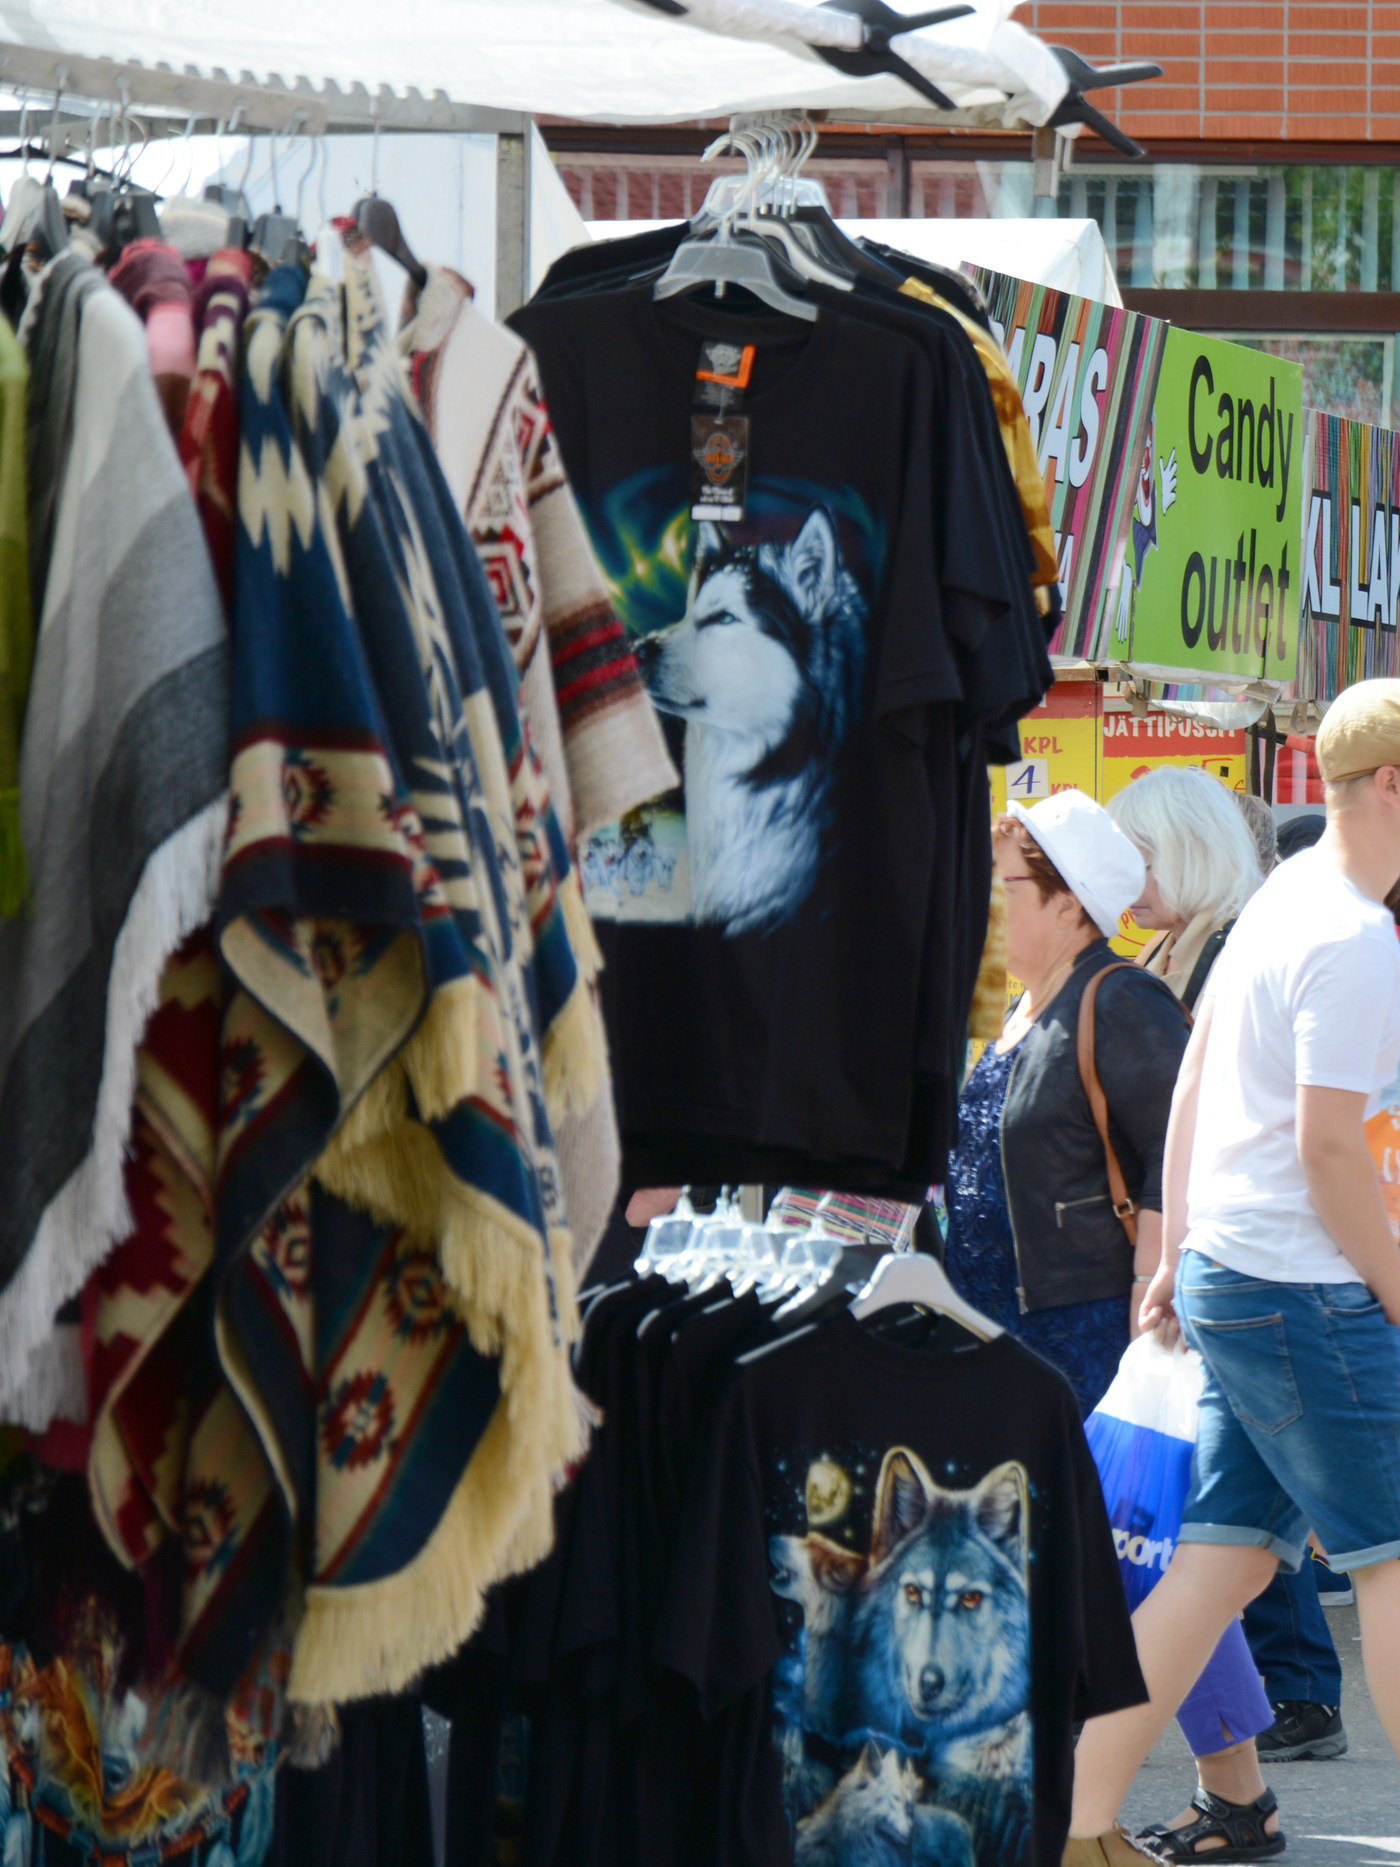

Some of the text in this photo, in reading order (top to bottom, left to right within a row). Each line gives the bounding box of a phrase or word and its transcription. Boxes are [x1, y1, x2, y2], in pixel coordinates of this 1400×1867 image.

[1188, 354, 1294, 523] Candy
[1180, 527, 1291, 662] outlet
[1302, 494, 1341, 619] KL
[1023, 736, 1063, 754] KPL
[1103, 715, 1236, 738] JÄTTIPUS
[1011, 765, 1041, 795] 4
